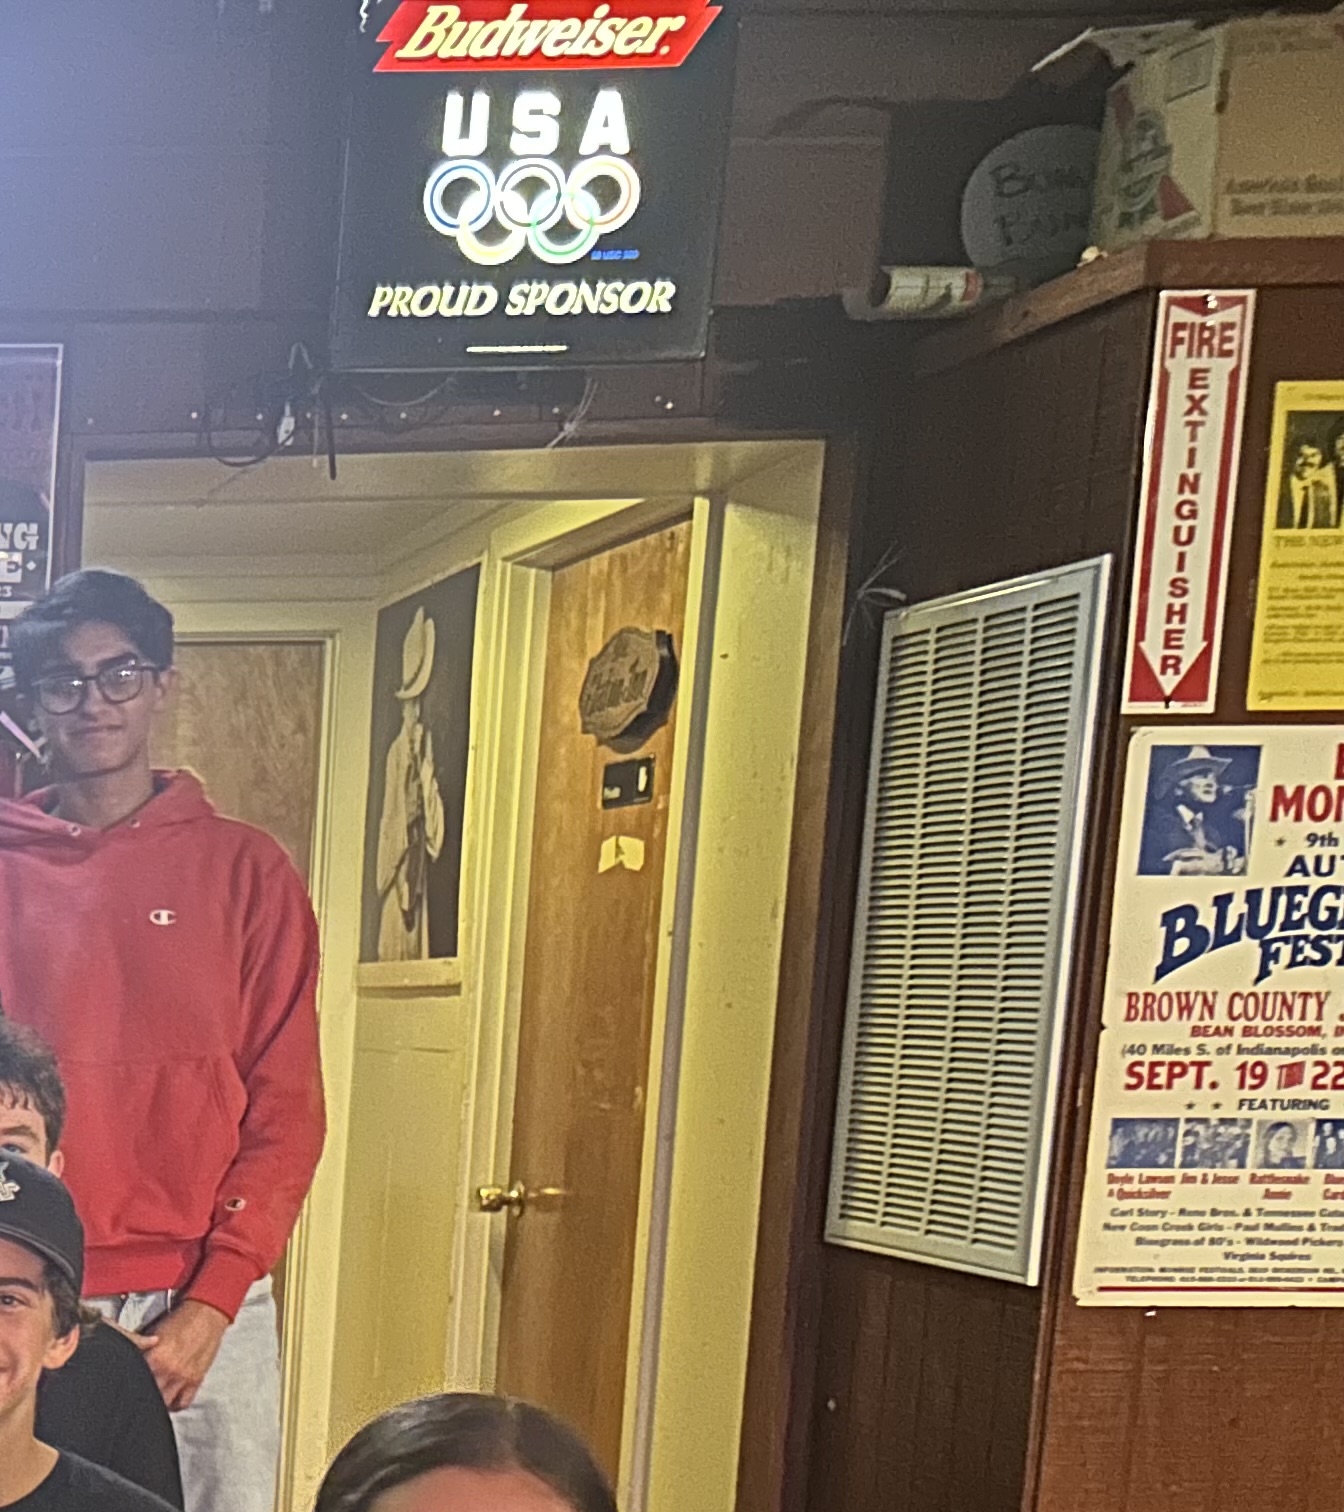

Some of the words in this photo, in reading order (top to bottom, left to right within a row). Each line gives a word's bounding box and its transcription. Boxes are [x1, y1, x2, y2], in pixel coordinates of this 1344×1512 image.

[368, 281, 499, 317] PROUD
[504, 280, 677, 316] SPONSOR
[1168, 321, 1237, 360] FIRE
[1159, 367, 1211, 677] EXTINGUISHER
[1306, 831, 1339, 848] 9th
[1283, 854, 1344, 878] AU
[1152, 885, 1344, 985] BLUEG
[1124, 991, 1218, 1022] BROWN
[1227, 991, 1331, 1022] COUNTY
[1190, 1025, 1234, 1038] BEAN
[1241, 1025, 1327, 1040] BLOSSOM,
[1151, 1043, 1191, 1056] Miles
[1196, 1043, 1211, 1056] S.
[1216, 1043, 1233, 1056] of
[1236, 1043, 1327, 1058] Indianapolis
[1123, 1060, 1220, 1091] SEPT.
[1235, 1060, 1269, 1090] 19
[1237, 1098, 1331, 1111] FEATURING
[1180, 1172, 1198, 1184] Jim
[1211, 1172, 1240, 1184] Jesse
[1248, 1172, 1311, 1184] Rattlesnake
[1110, 1208, 1134, 1217] Carl
[1137, 1208, 1168, 1219] Story
[1211, 1208, 1240, 1217] Bros.
[1242, 1208, 1252, 1217] &
[1255, 1208, 1316, 1217] Tennessee
[1198, 1222, 1224, 1231] Girls
[1235, 1222, 1260, 1231] Paul
[1306, 1222, 1316, 1231] &
[1245, 1237, 1299, 1246] Wildwood
[1223, 1251, 1266, 1262] Virginia
[1269, 1251, 1311, 1262] Squires
